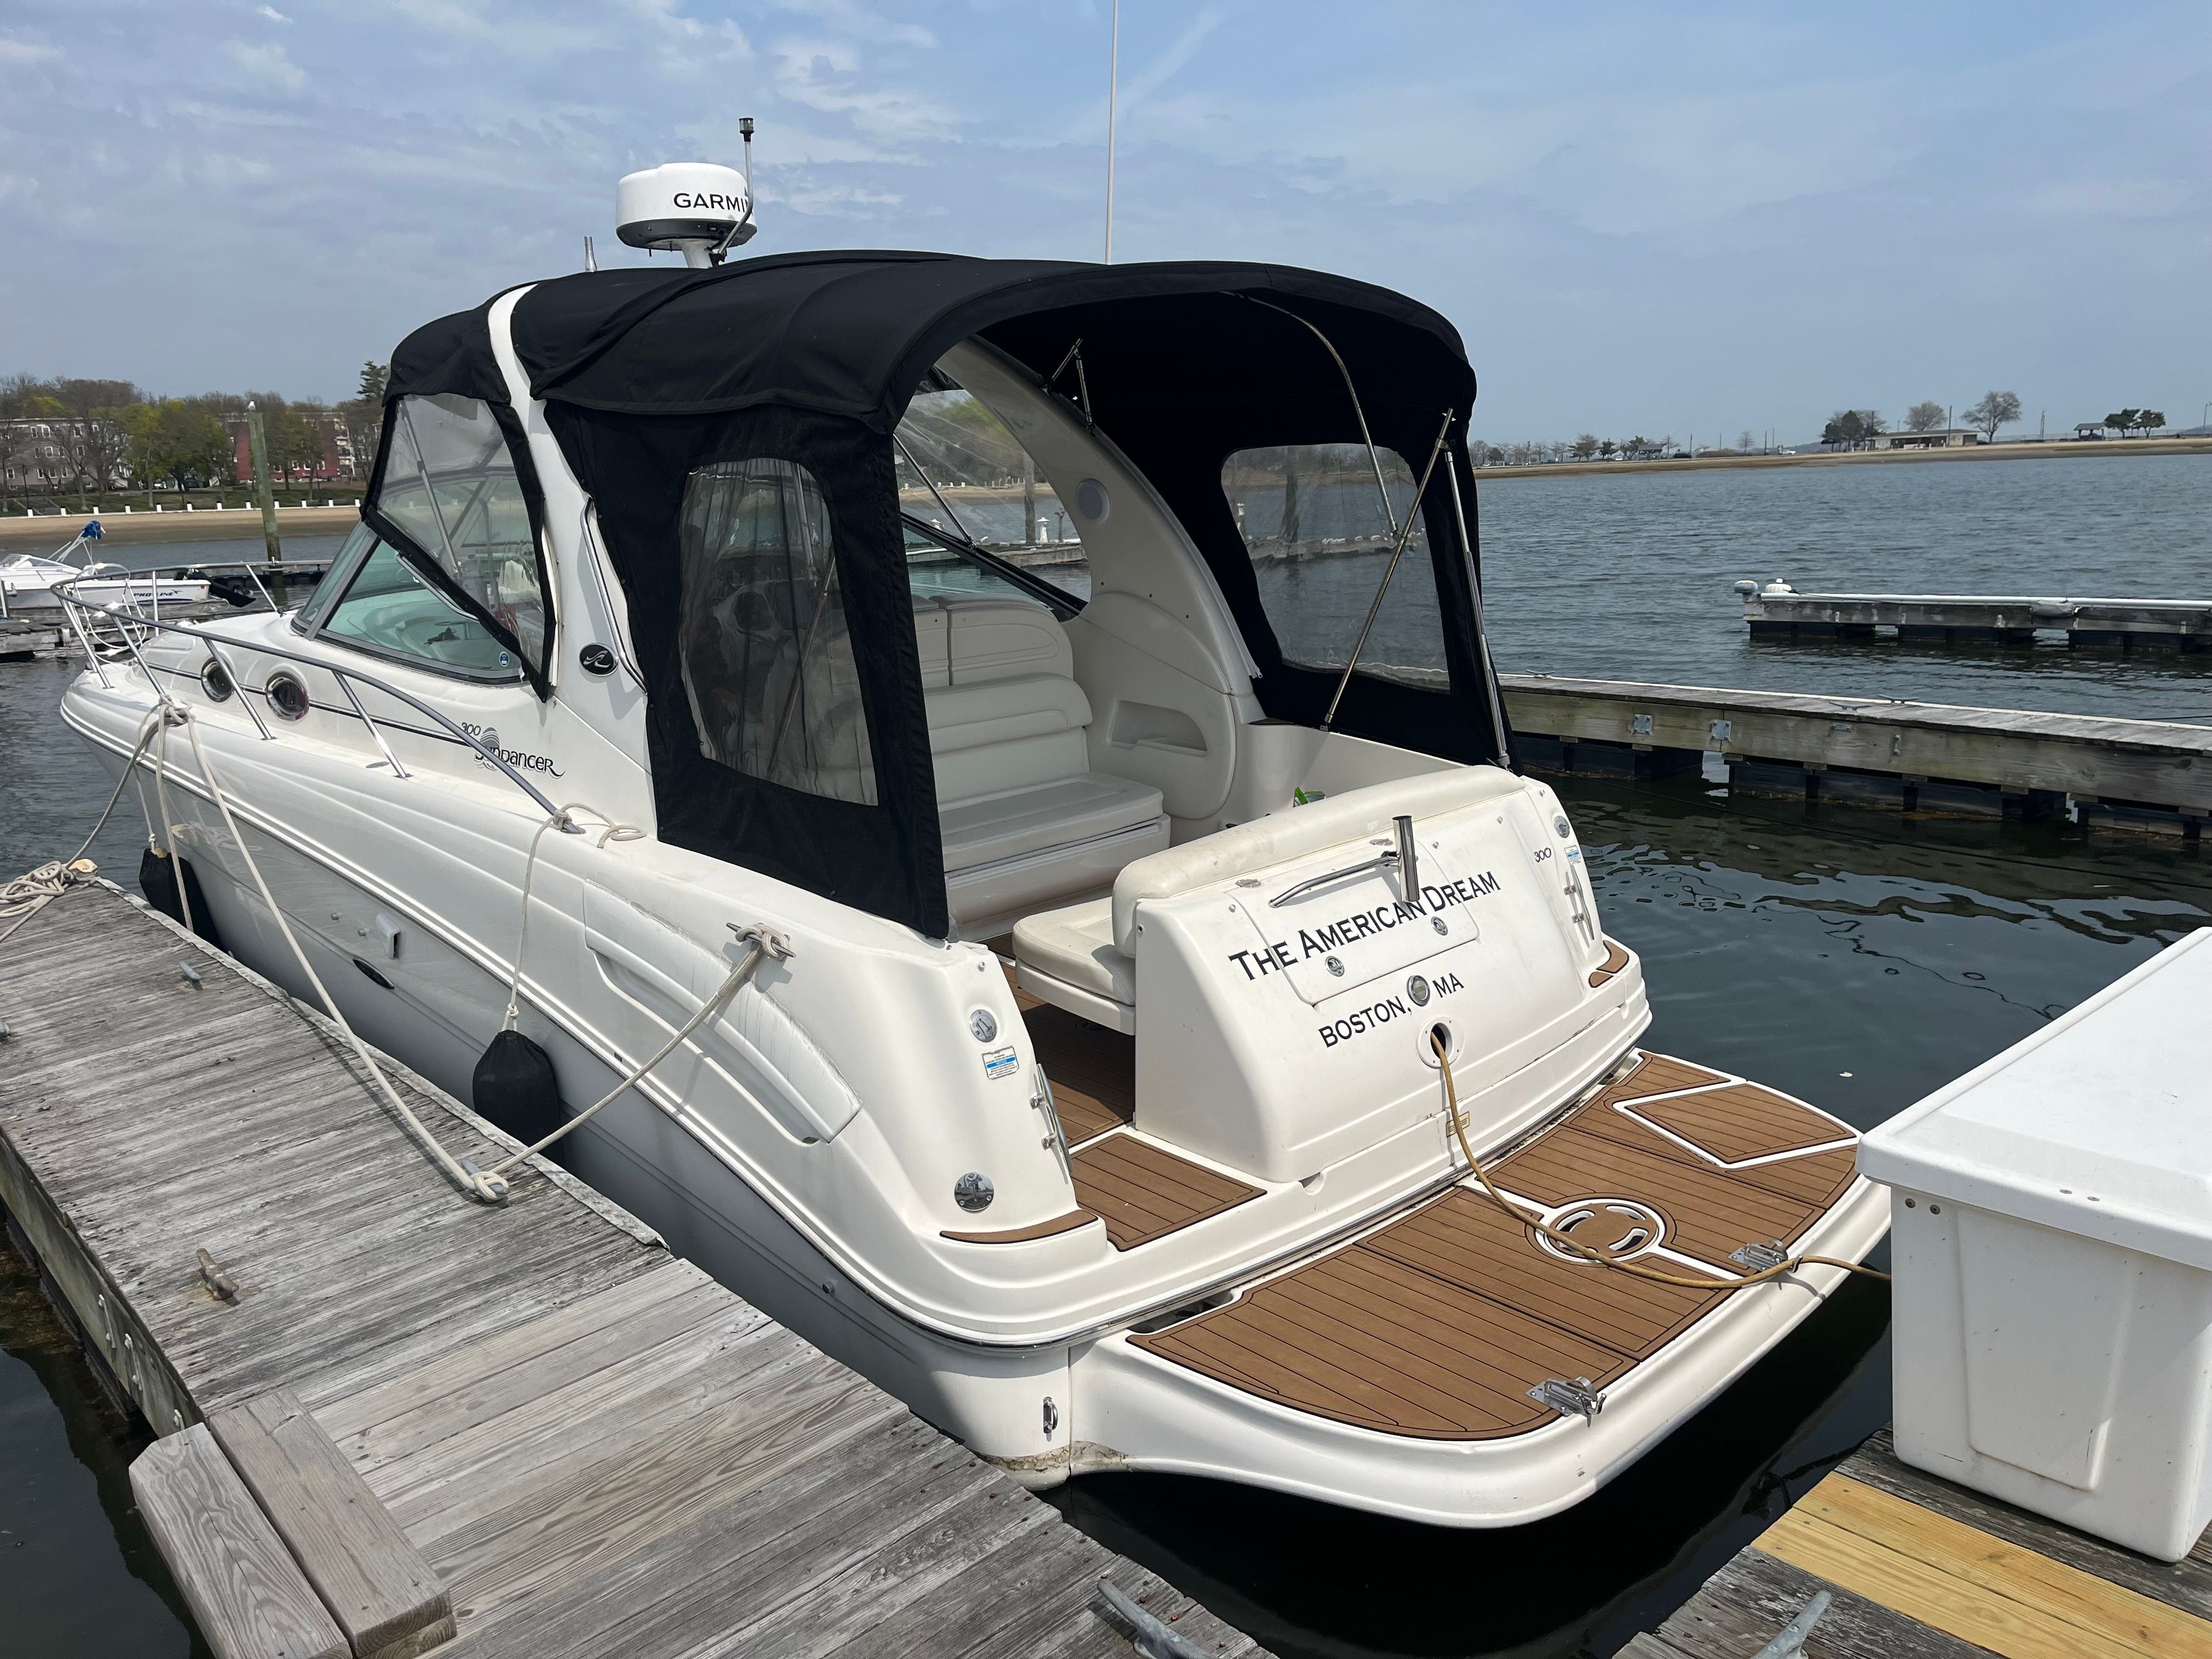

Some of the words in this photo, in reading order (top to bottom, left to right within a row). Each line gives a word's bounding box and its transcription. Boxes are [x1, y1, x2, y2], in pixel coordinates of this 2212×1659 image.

[1534, 848, 1551, 862] 300
[1228, 941, 1299, 980] THE
[1297, 900, 1427, 958] AMERICAN
[1421, 871, 1501, 912] DREAM
[1318, 996, 1412, 1047] BOSTON,
[1432, 973, 1464, 998] MA
